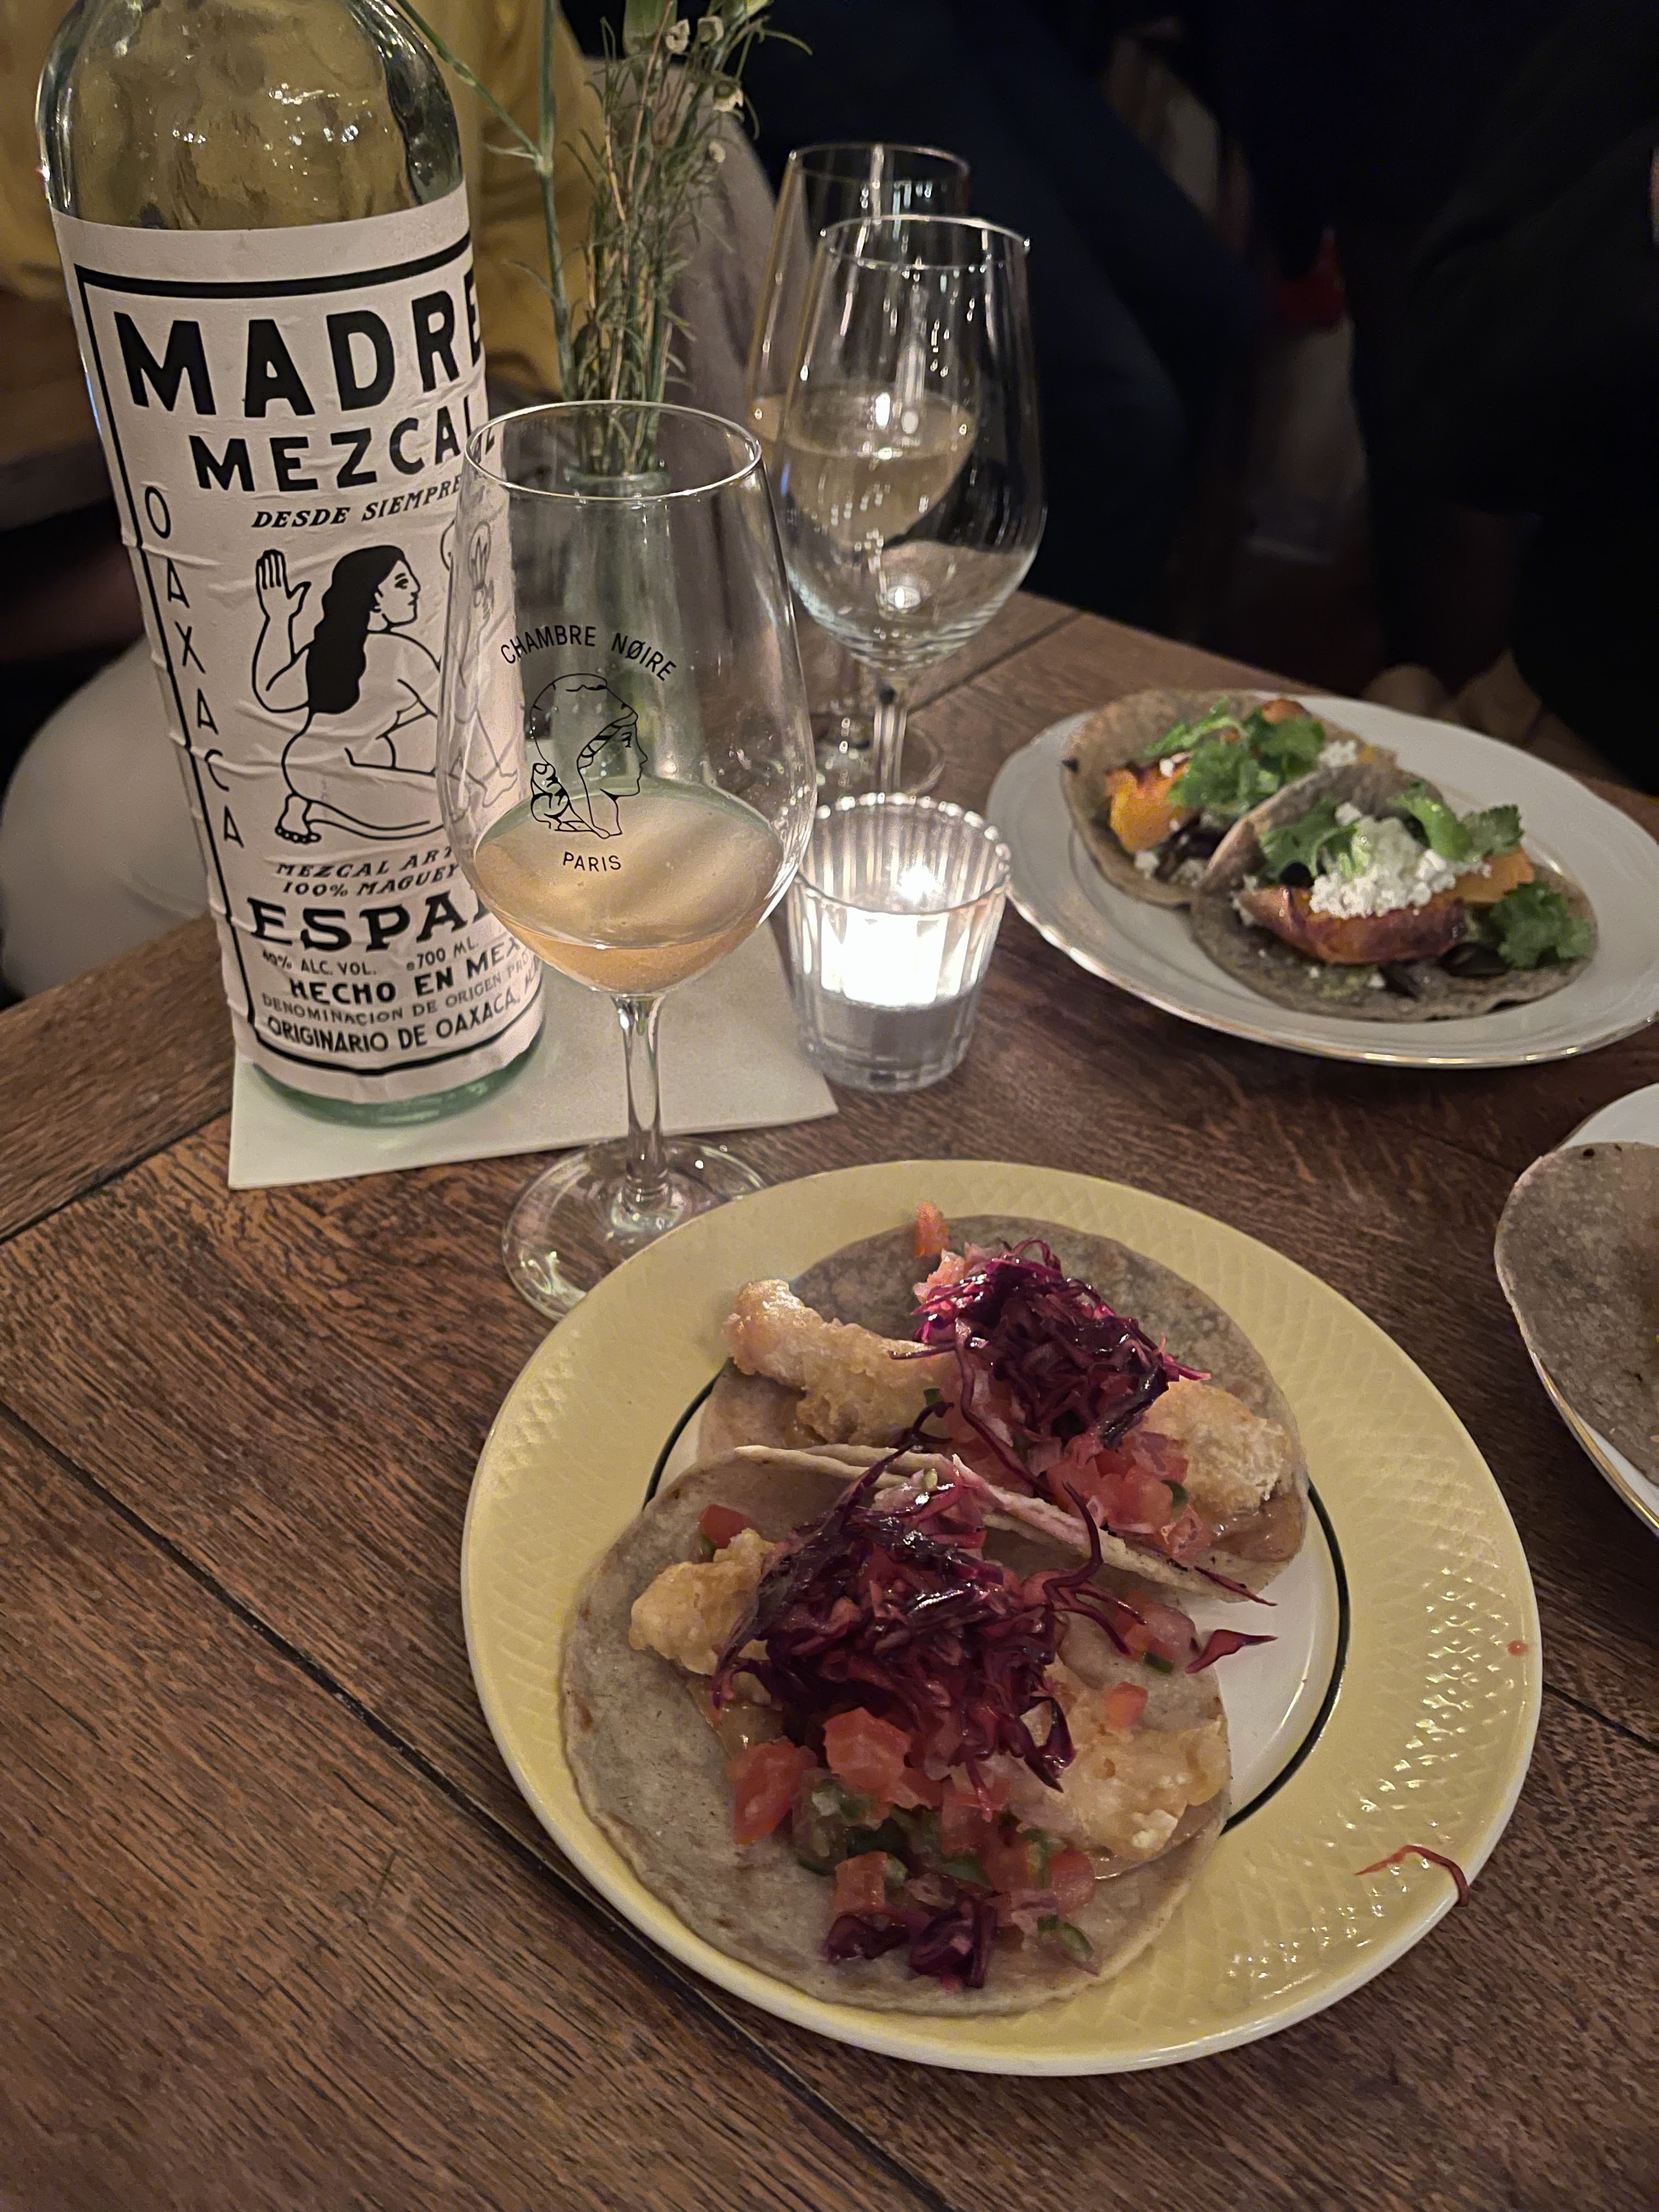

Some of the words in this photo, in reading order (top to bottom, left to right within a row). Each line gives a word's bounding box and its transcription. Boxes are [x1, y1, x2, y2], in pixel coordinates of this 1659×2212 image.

[114, 269, 481, 417] MADRE
[251, 507, 350, 528] DESDE
[361, 474, 461, 522] SIEMPRE
[500, 625, 596, 664] CHAMBRE
[611, 633, 676, 681] NØIRE
[276, 860, 390, 878] MEZCAL
[283, 882, 348, 897] 100%
[357, 864, 459, 896] MAGUEY
[563, 851, 622, 872] PARIS
[247, 890, 490, 953] ESPA
[301, 958, 332, 975] ALC.
[337, 962, 376, 975] VOL.
[262, 992, 403, 1026] DENOMINACION
[413, 1000, 438, 1017] DE
[445, 972, 502, 1008] ORIGEN
[290, 977, 397, 1005] HECHO
[414, 967, 454, 997] EN
[267, 1017, 388, 1053] ORIGINARIO
[398, 1024, 428, 1051] DE
